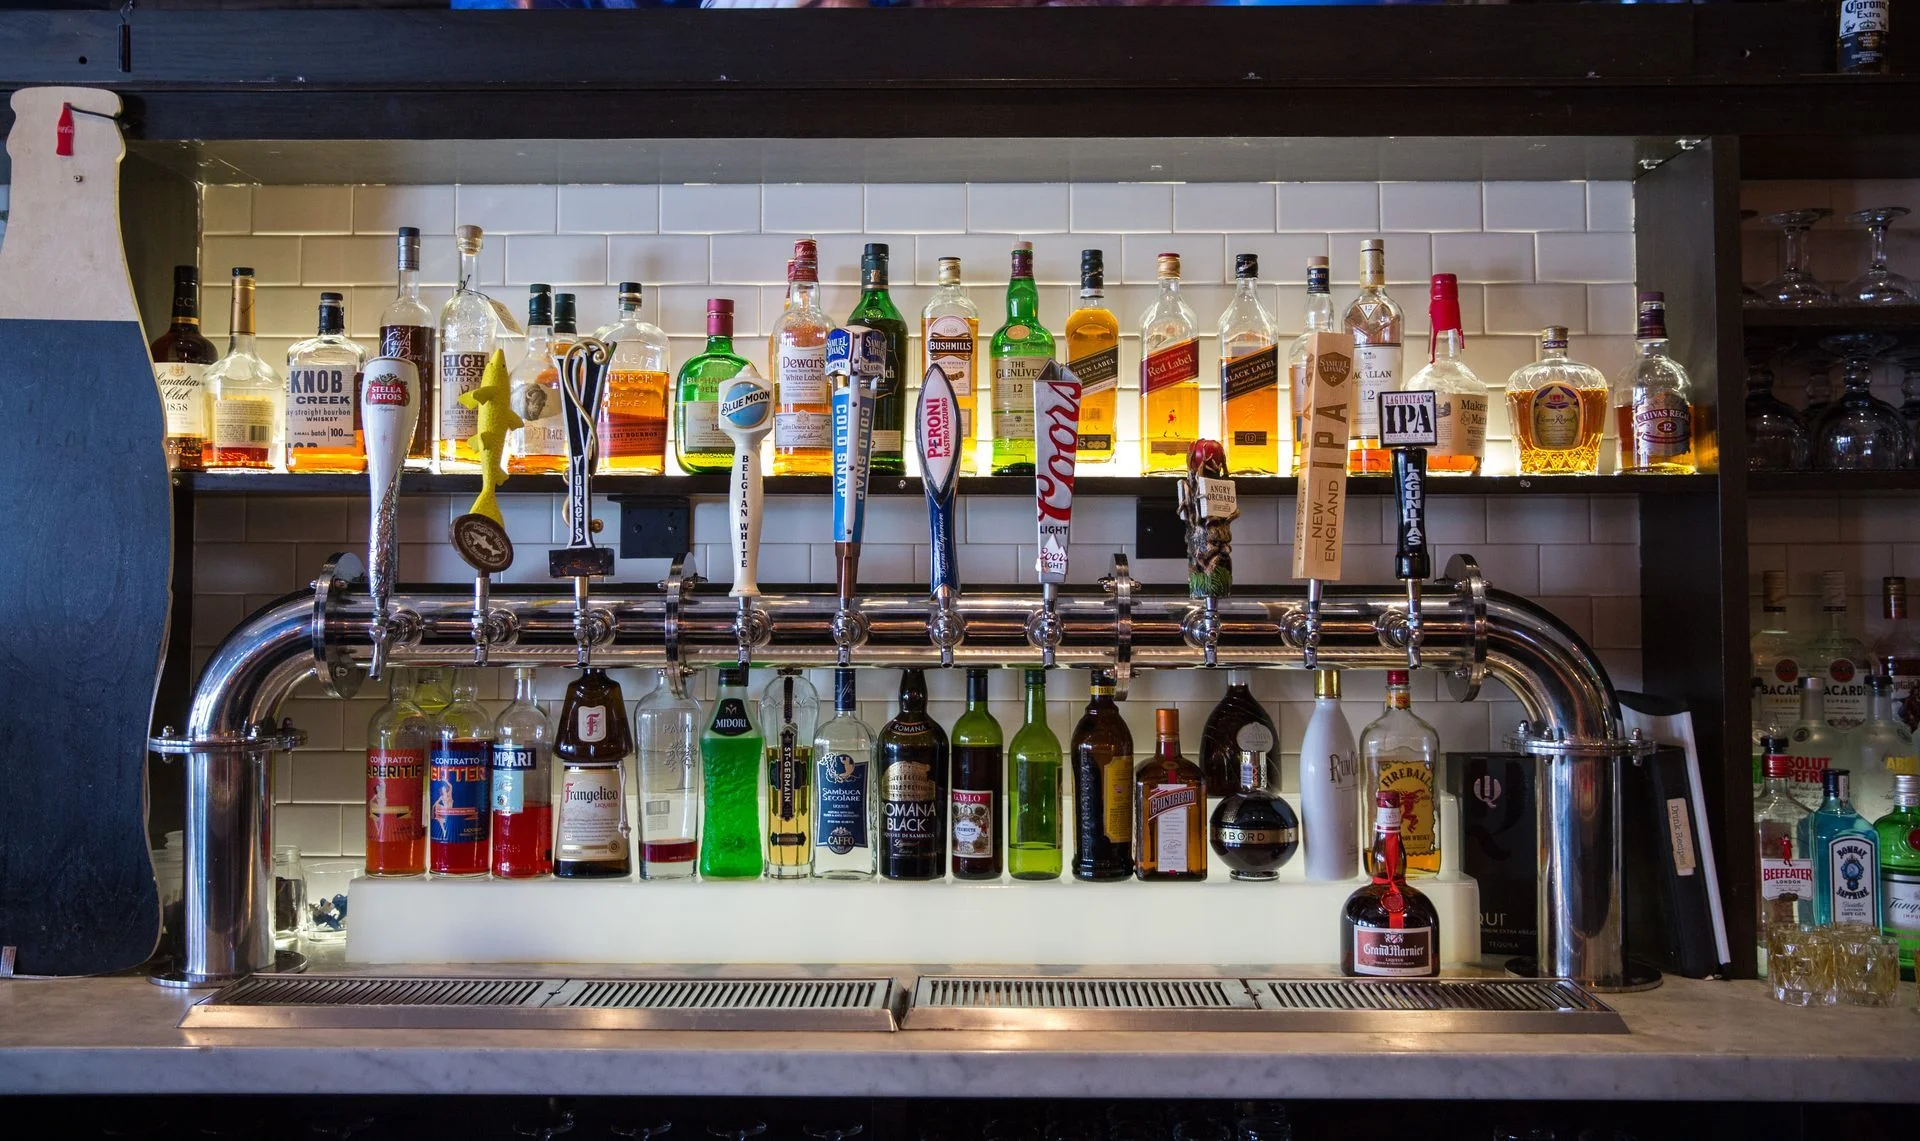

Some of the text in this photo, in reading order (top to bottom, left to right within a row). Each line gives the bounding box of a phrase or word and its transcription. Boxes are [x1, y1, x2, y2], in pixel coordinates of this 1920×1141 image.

[828, 336, 848, 348] SAMUEL
[930, 341, 972, 351] BUSHMILLS
[827, 345, 846, 356] ADAMS
[443, 354, 486, 368] HIGH
[782, 356, 825, 368] Dewar's
[1011, 360, 1026, 368] THE
[1094, 358, 1116, 370] LABEL
[1148, 366, 1166, 377] Red
[1168, 354, 1193, 369] Label
[1320, 360, 1349, 369] SAMUEL
[443, 368, 486, 376] WEST
[1224, 360, 1276, 383] BLACK LABEL
[1323, 366, 1346, 374] ADAMS
[1352, 370, 1392, 380] ACALLAN
[291, 370, 342, 394] KNOB
[1013, 384, 1024, 393] 12
[163, 386, 192, 400] Club
[372, 385, 402, 393] STELLA
[1362, 390, 1375, 400] 12
[296, 396, 350, 404] CREEK
[721, 391, 770, 416] BLUE MOON
[1386, 394, 1425, 404] LAGUNITAS
[166, 402, 188, 412] 1858
[295, 408, 321, 416] straight
[324, 408, 351, 416] bourbon
[1385, 404, 1433, 434] IPA
[1636, 410, 1668, 424] CHIVAS
[330, 428, 344, 436] 100
[926, 398, 944, 459] PERONI
[941, 397, 951, 458] NASTRO AZZURRO
[1663, 422, 1672, 431] 12
[1313, 403, 1348, 470] IPA
[836, 404, 848, 498] COLD SNAP
[854, 406, 870, 500] COLD SNAP
[1037, 382, 1082, 522] Coors
[1210, 485, 1231, 495] ANGRY
[1208, 494, 1235, 504] ORCHARD
[1406, 462, 1422, 546] LAGUNITAS
[740, 455, 749, 568] BELGIAN WHITE
[1312, 502, 1325, 539] NEW
[1324, 480, 1339, 562] ENGLAND
[1040, 526, 1068, 535] LIGHT
[1041, 562, 1064, 570] LIGHT
[1762, 685, 1800, 696] BACAR
[716, 718, 748, 729] MIDORI
[894, 724, 926, 732] ROMANA
[370, 756, 414, 764] CONTRATTO
[435, 757, 480, 765] CONTRATTO
[493, 751, 533, 766] MPARI
[1789, 756, 1831, 770] SOLUT
[368, 765, 422, 778] APERITIF
[430, 766, 487, 782] BITTER
[784, 746, 792, 802] ST-GERMAIN
[564, 782, 618, 804] Frangelico
[1150, 790, 1195, 816] COINTREAU
[1671, 804, 1682, 831] Drink
[887, 818, 926, 832] BLACK
[828, 836, 854, 845] CAFFO
[1836, 846, 1868, 860] BOMBAY
[1764, 868, 1812, 882] BEEFEATER
[1836, 886, 1870, 900] SAPPHIRE
